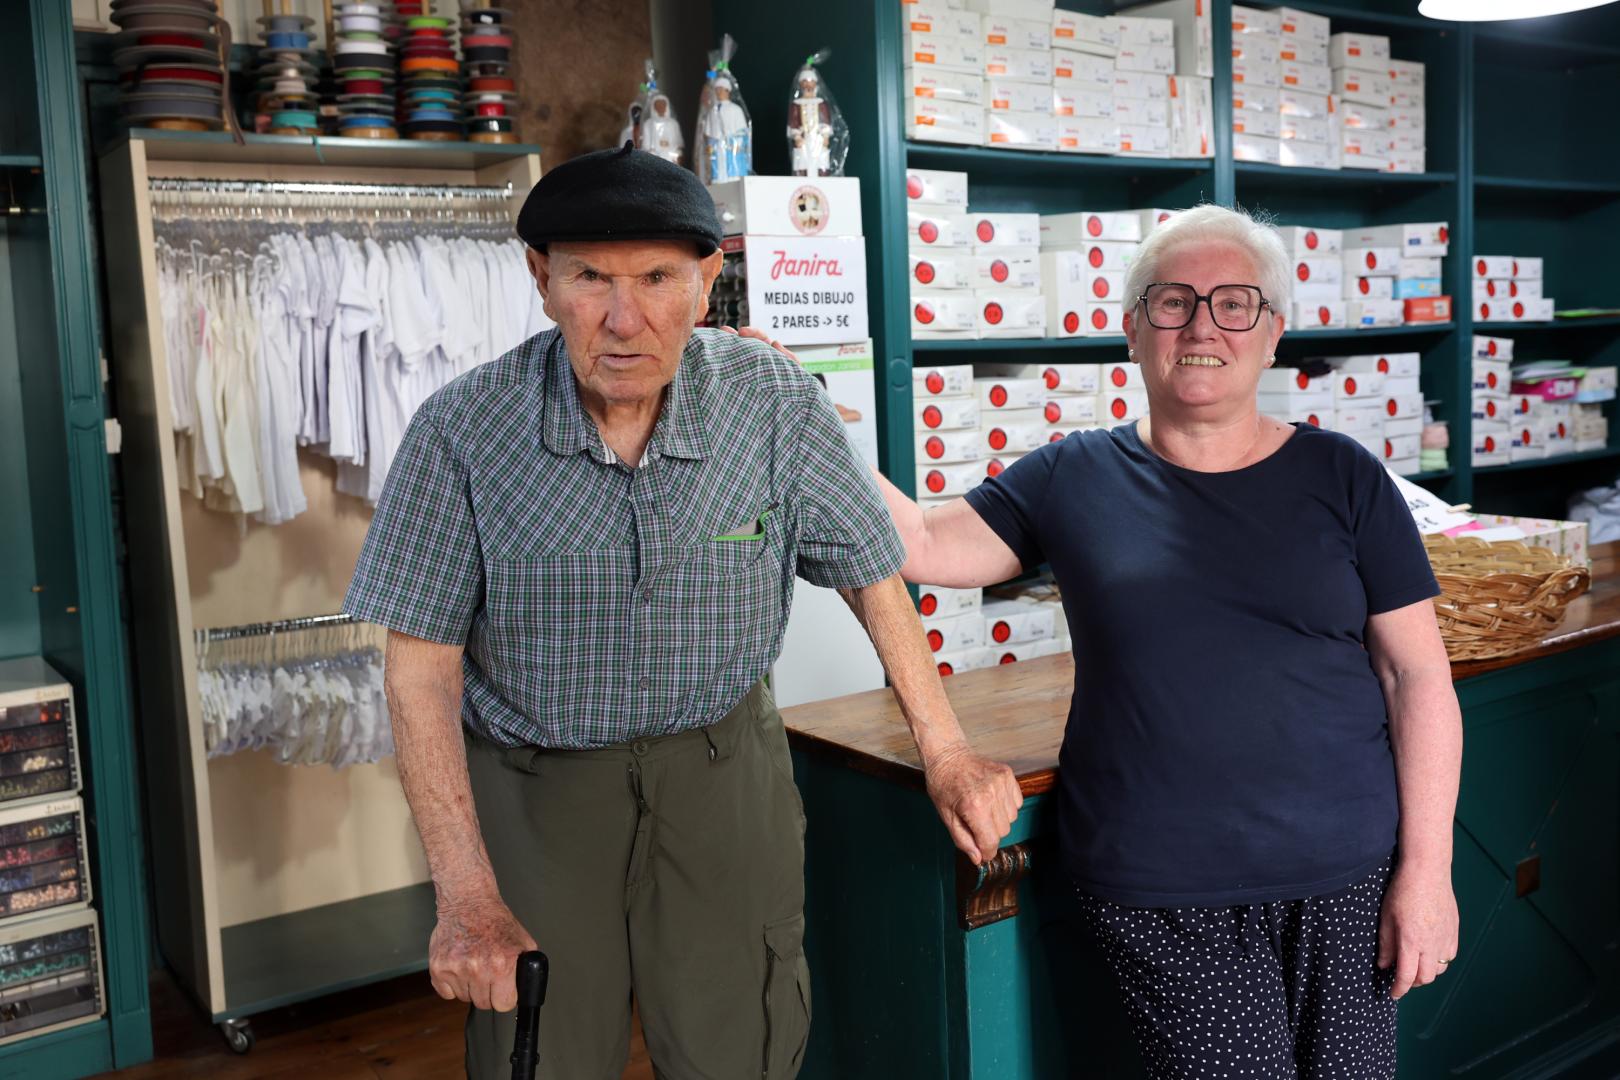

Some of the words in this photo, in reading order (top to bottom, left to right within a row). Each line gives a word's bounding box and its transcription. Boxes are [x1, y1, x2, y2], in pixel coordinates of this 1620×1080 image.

[771, 250, 842, 280] Janira
[764, 291, 809, 305] MEDIAS
[813, 291, 854, 304] DIBUJO
[772, 315, 779, 329] 2
[783, 315, 820, 328] PARES
[836, 315, 849, 327] 5€
